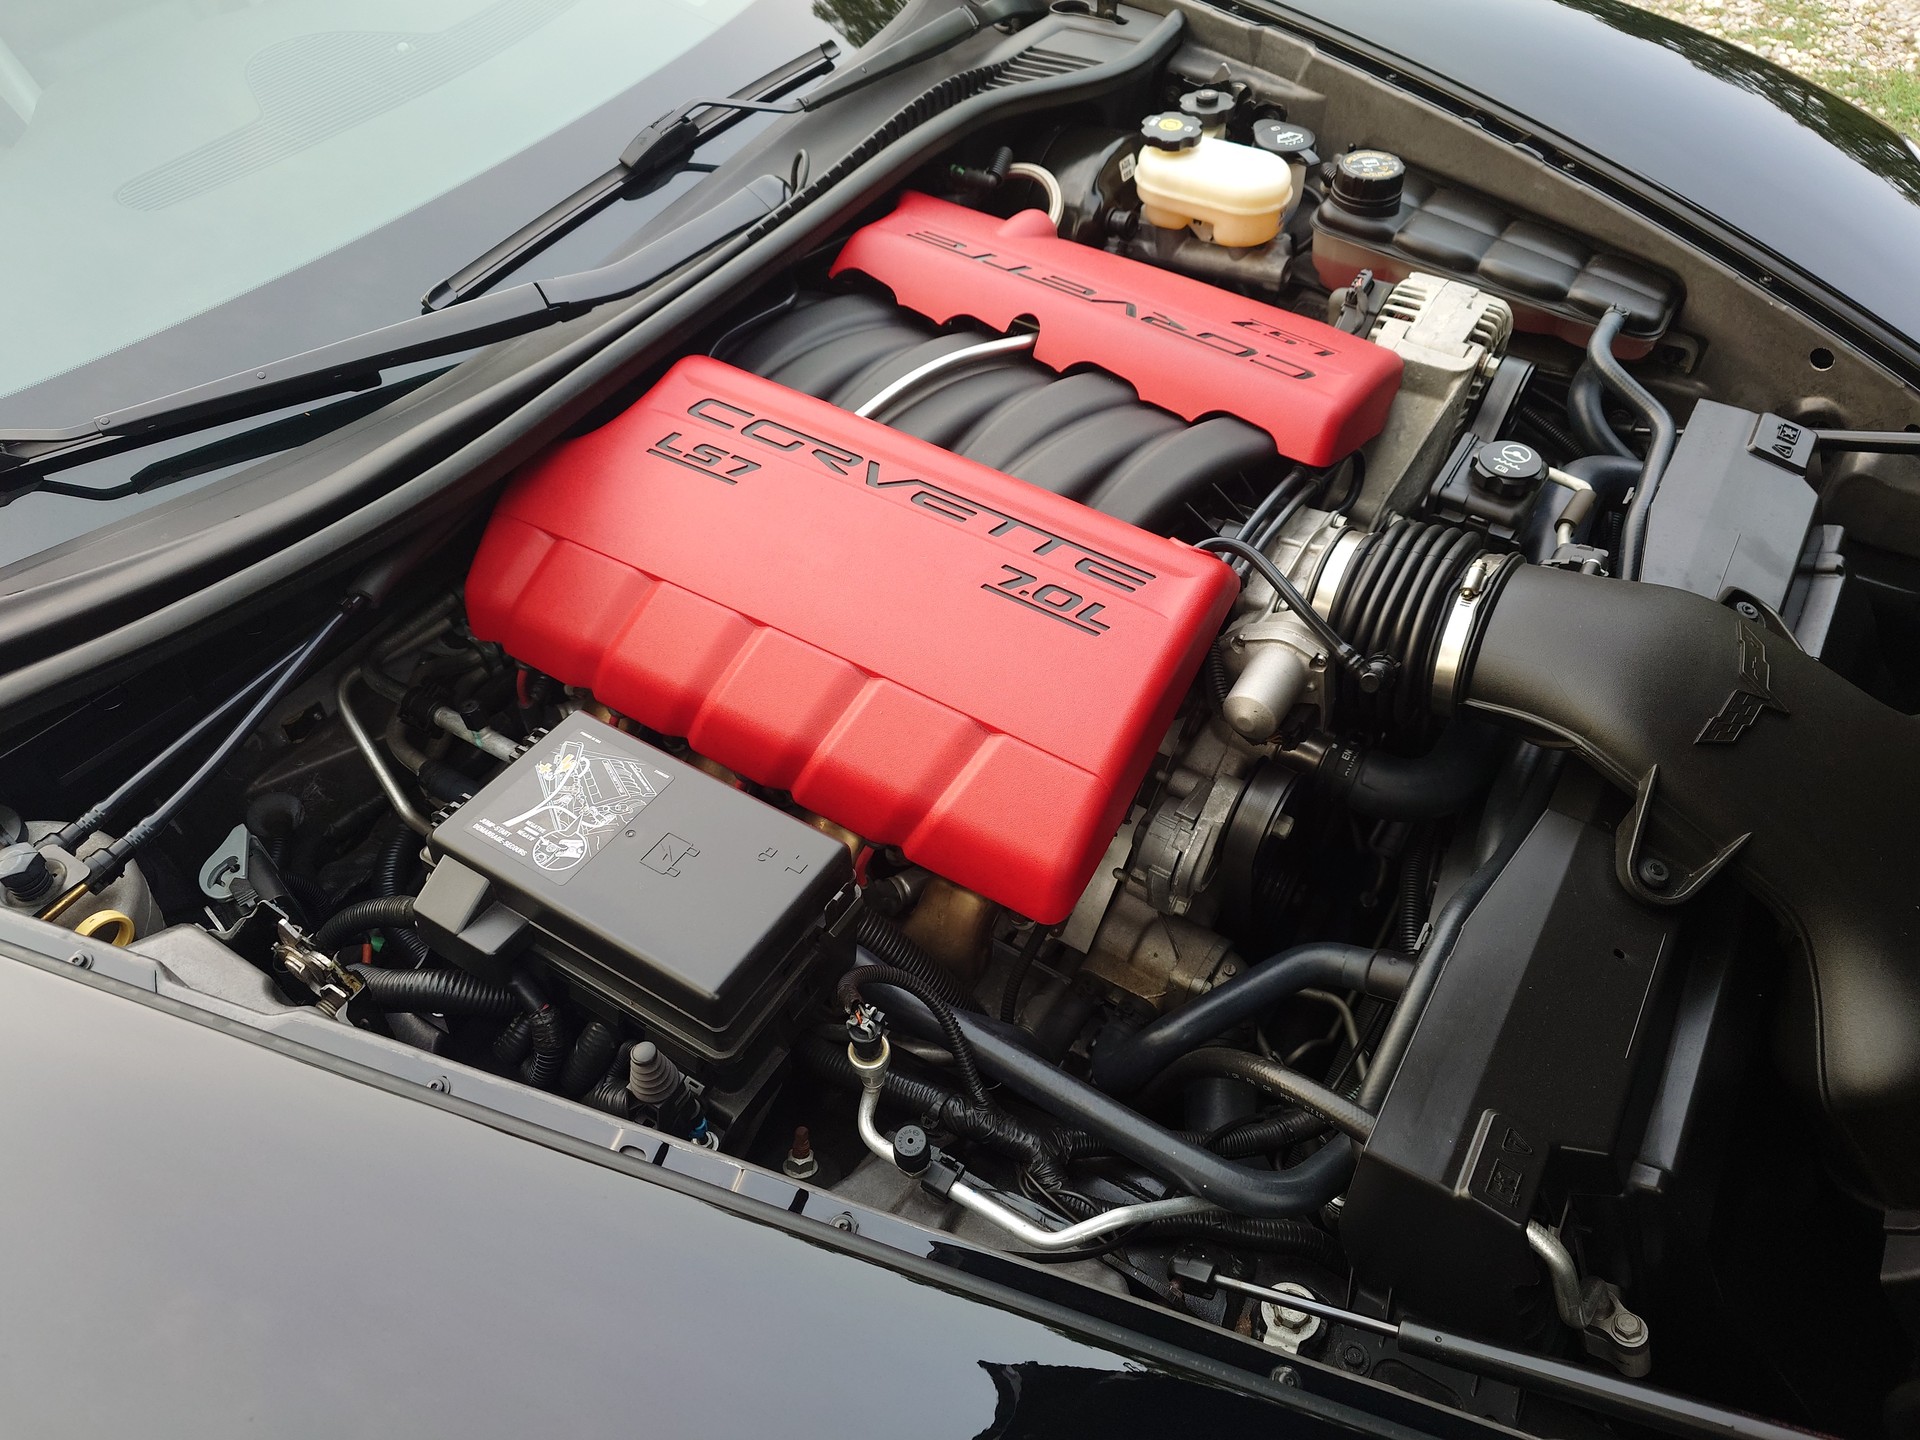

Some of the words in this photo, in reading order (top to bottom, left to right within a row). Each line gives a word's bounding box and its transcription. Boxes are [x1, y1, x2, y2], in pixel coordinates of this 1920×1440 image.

[906, 231, 1317, 380] CORVETTE
[1231, 321, 1336, 357] LS7
[655, 431, 763, 477] LS7
[686, 398, 1157, 593] CORVETTE
[996, 563, 1112, 632] 7.0L
[479, 818, 513, 838] JUMP-START
